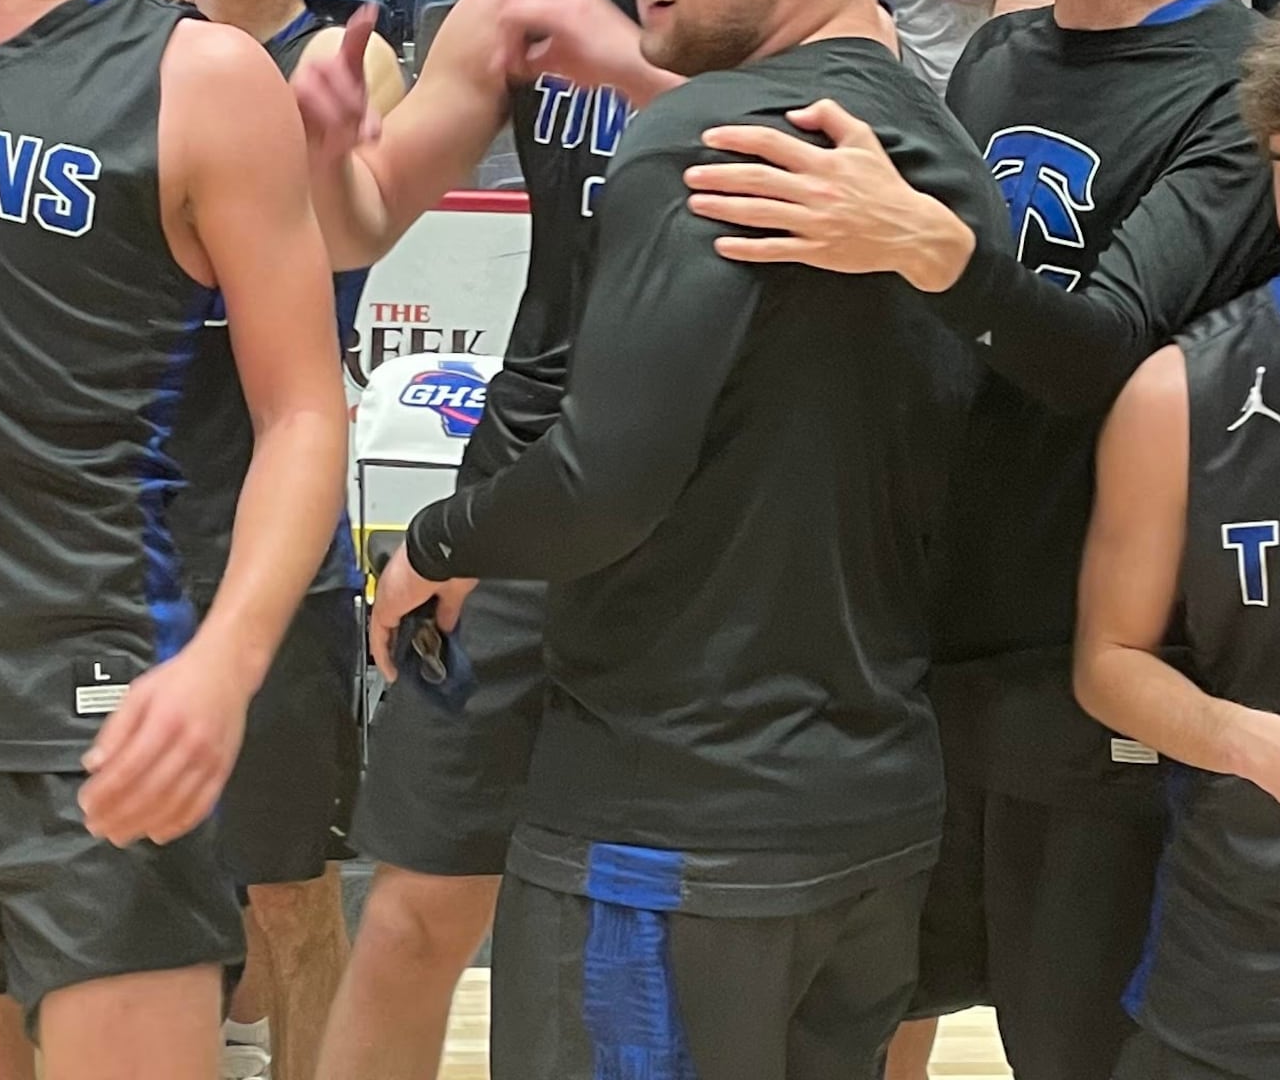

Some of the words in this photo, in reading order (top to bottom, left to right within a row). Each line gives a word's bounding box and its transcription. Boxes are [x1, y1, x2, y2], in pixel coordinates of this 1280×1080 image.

[370, 303, 431, 323] THE
[401, 383, 487, 407] GHS
[94, 662, 111, 681] L
